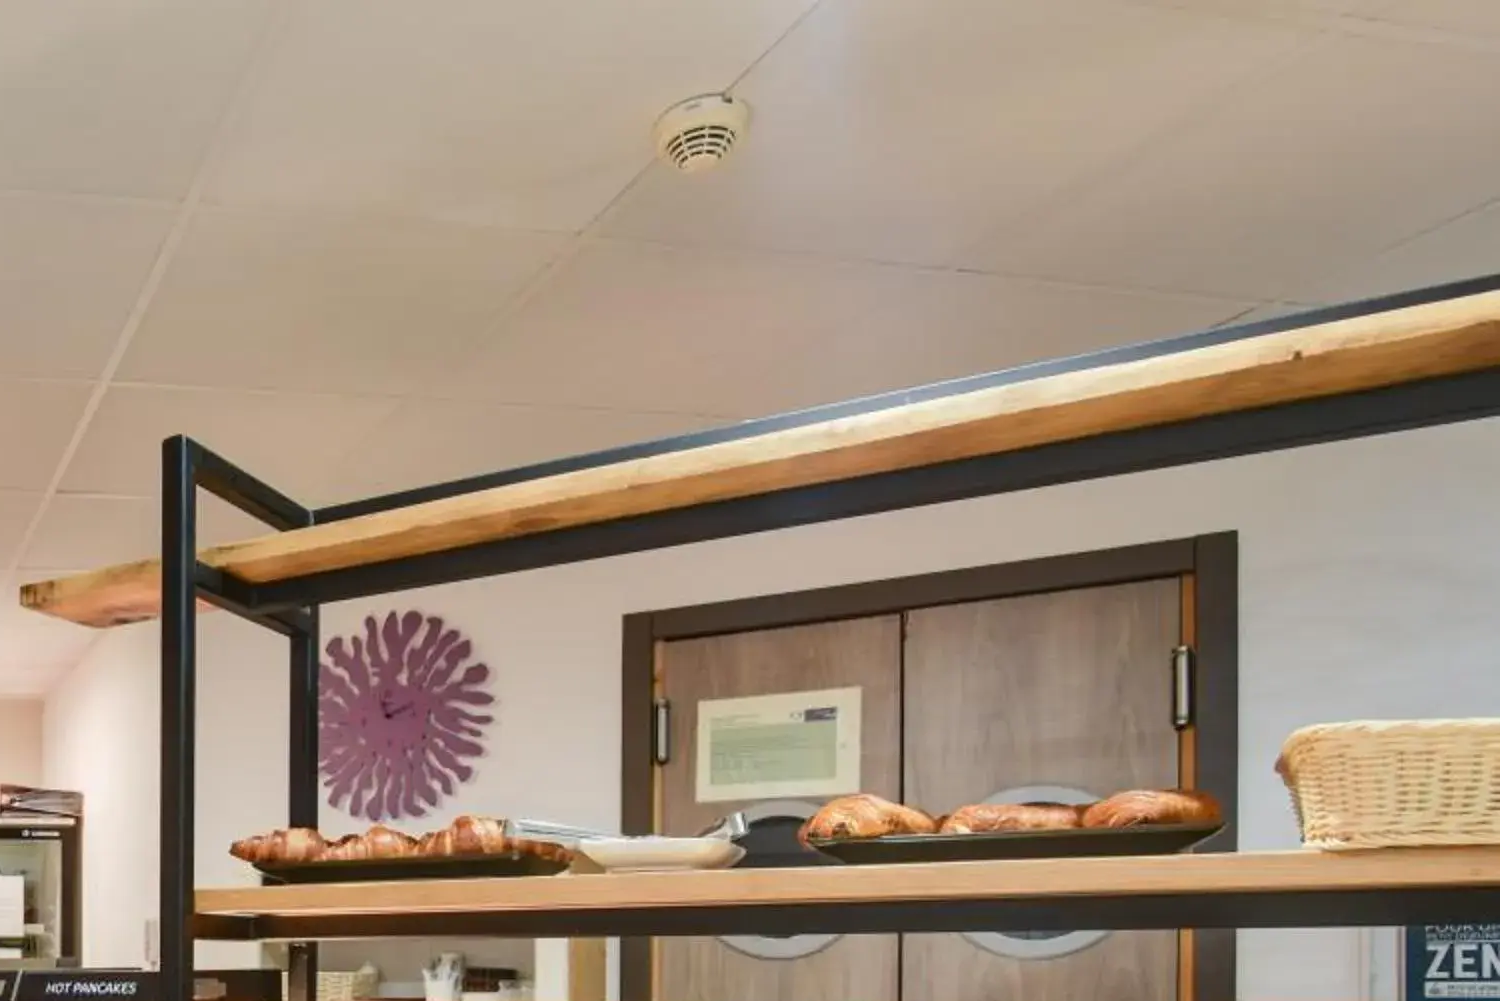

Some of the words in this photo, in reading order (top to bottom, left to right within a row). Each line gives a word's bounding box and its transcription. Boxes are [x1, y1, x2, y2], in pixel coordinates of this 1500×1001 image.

[1426, 943, 1500, 978] ZEN
[45, 982, 72, 994] HOT
[72, 981, 137, 995] PANCAKES
